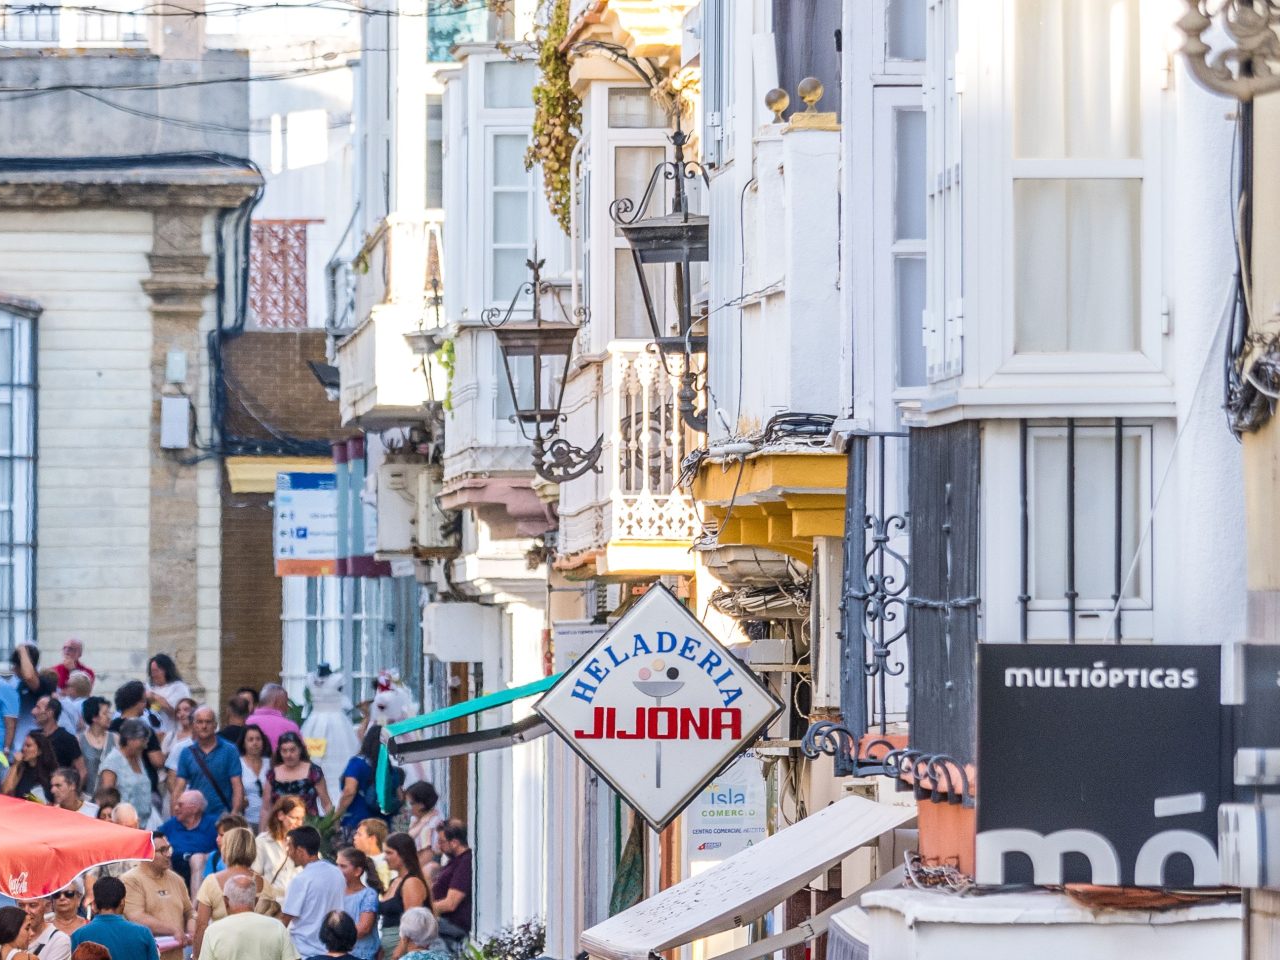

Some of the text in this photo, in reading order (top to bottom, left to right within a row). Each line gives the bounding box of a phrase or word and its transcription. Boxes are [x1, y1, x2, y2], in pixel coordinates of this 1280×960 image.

[571, 631, 744, 708] HELADERIA
[574, 706, 742, 740] JIJONA
[711, 788, 745, 804] isla
[701, 809, 756, 817] COMERCO
